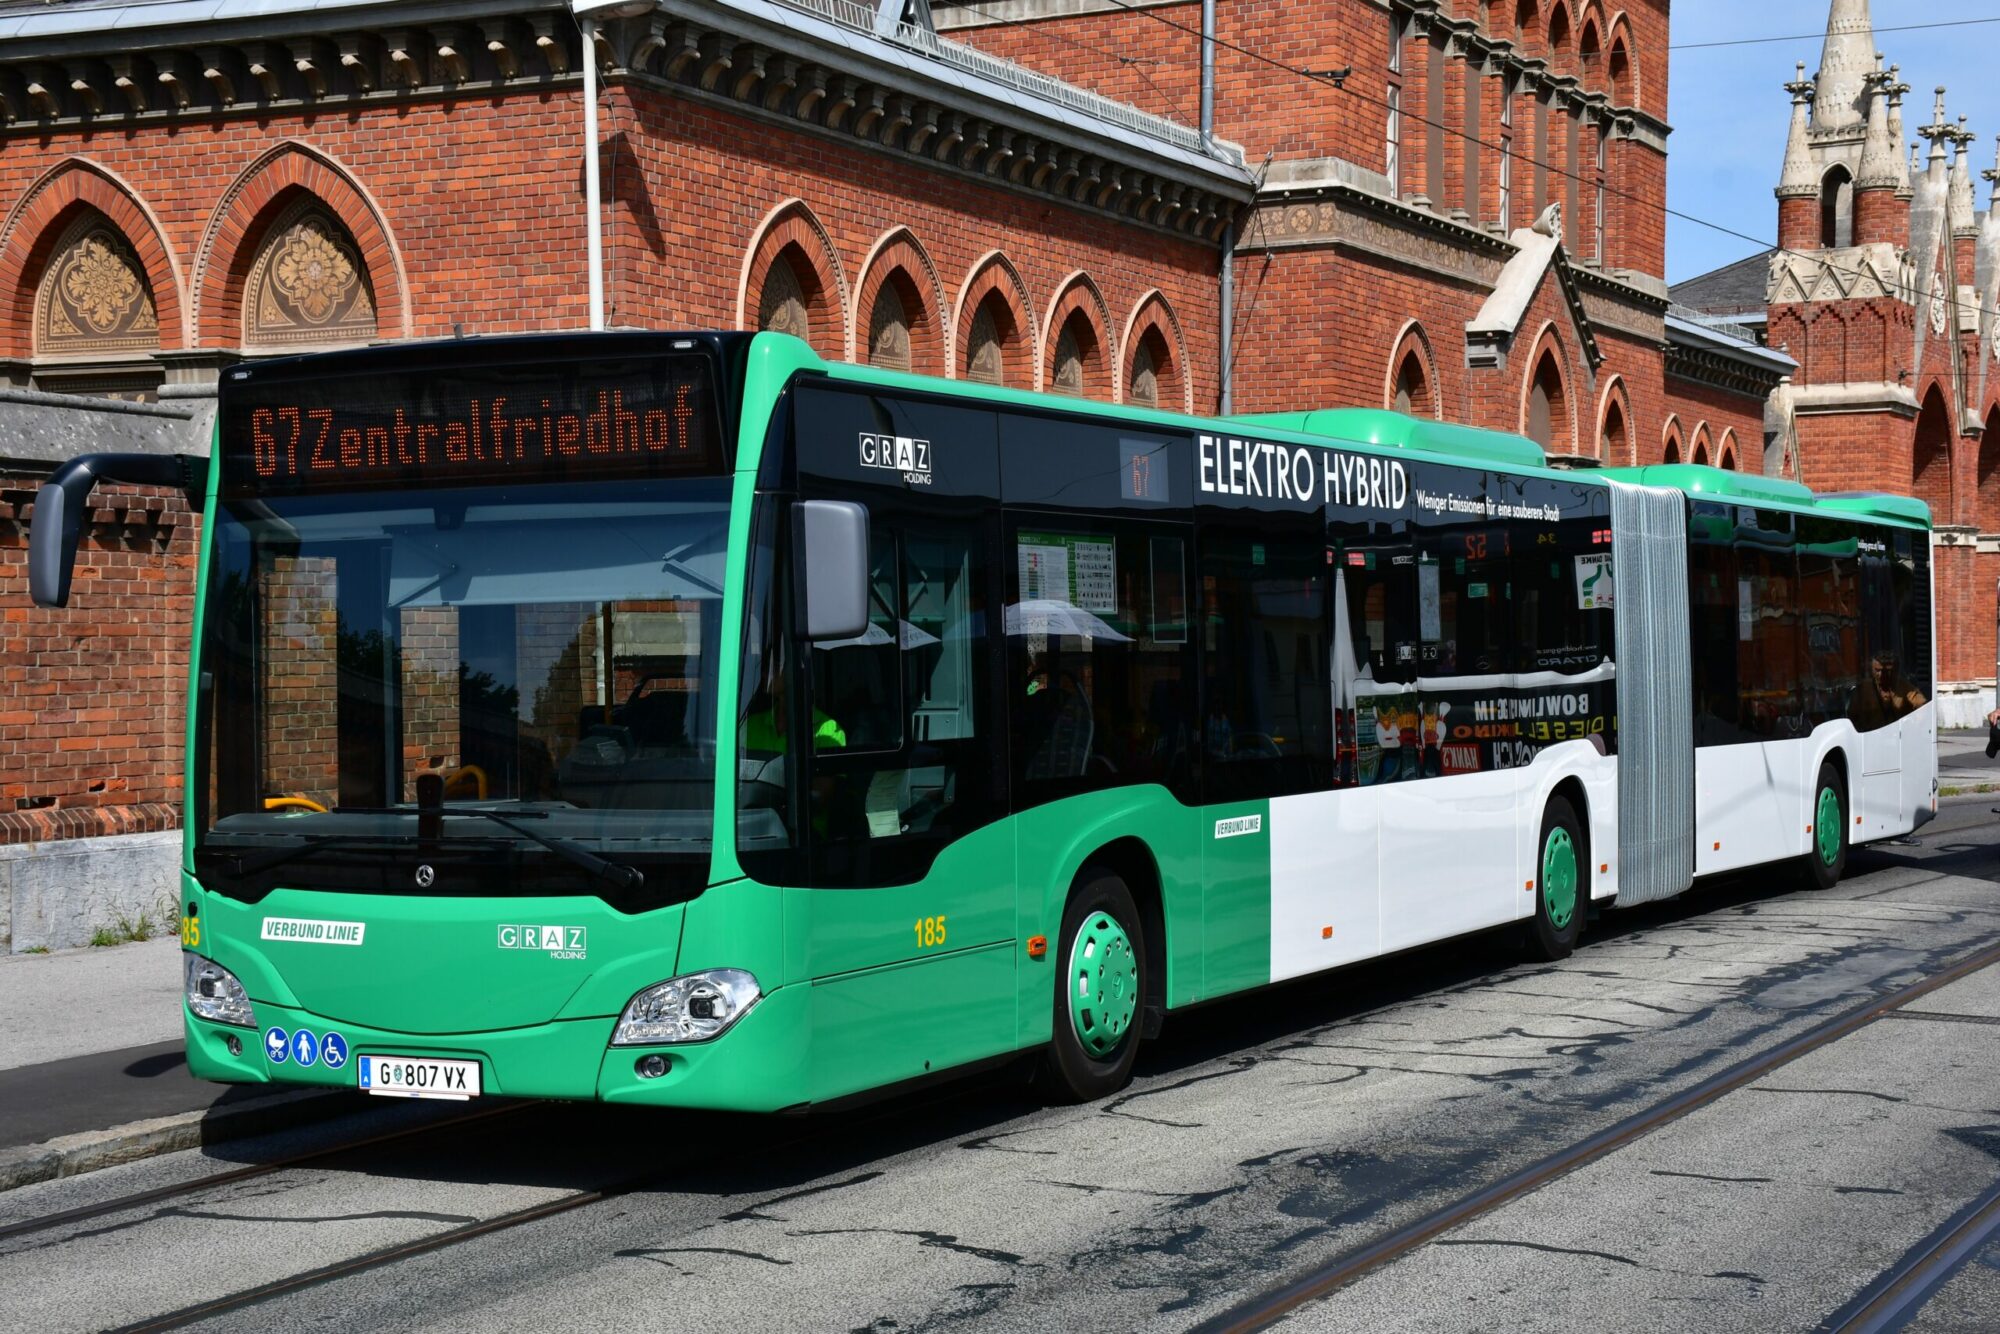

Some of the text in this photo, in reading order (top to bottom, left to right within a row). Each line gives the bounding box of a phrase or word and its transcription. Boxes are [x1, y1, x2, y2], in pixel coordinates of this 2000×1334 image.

[251, 384, 693, 476] 67 Zentralfriedhof
[861, 437, 928, 469] GRAZ
[903, 471, 932, 485] HOLDING
[1199, 435, 1407, 509] ELEKTRO HYBRID
[1416, 489, 1560, 522] Weniger Emissionen für eine sauberere Stadt
[266, 920, 360, 941] VERBUND LINIE
[500, 927, 582, 949] GRAZ
[914, 916, 946, 948] 185
[550, 950, 587, 960] HOLDING
[380, 1062, 466, 1089] G 807 VX
